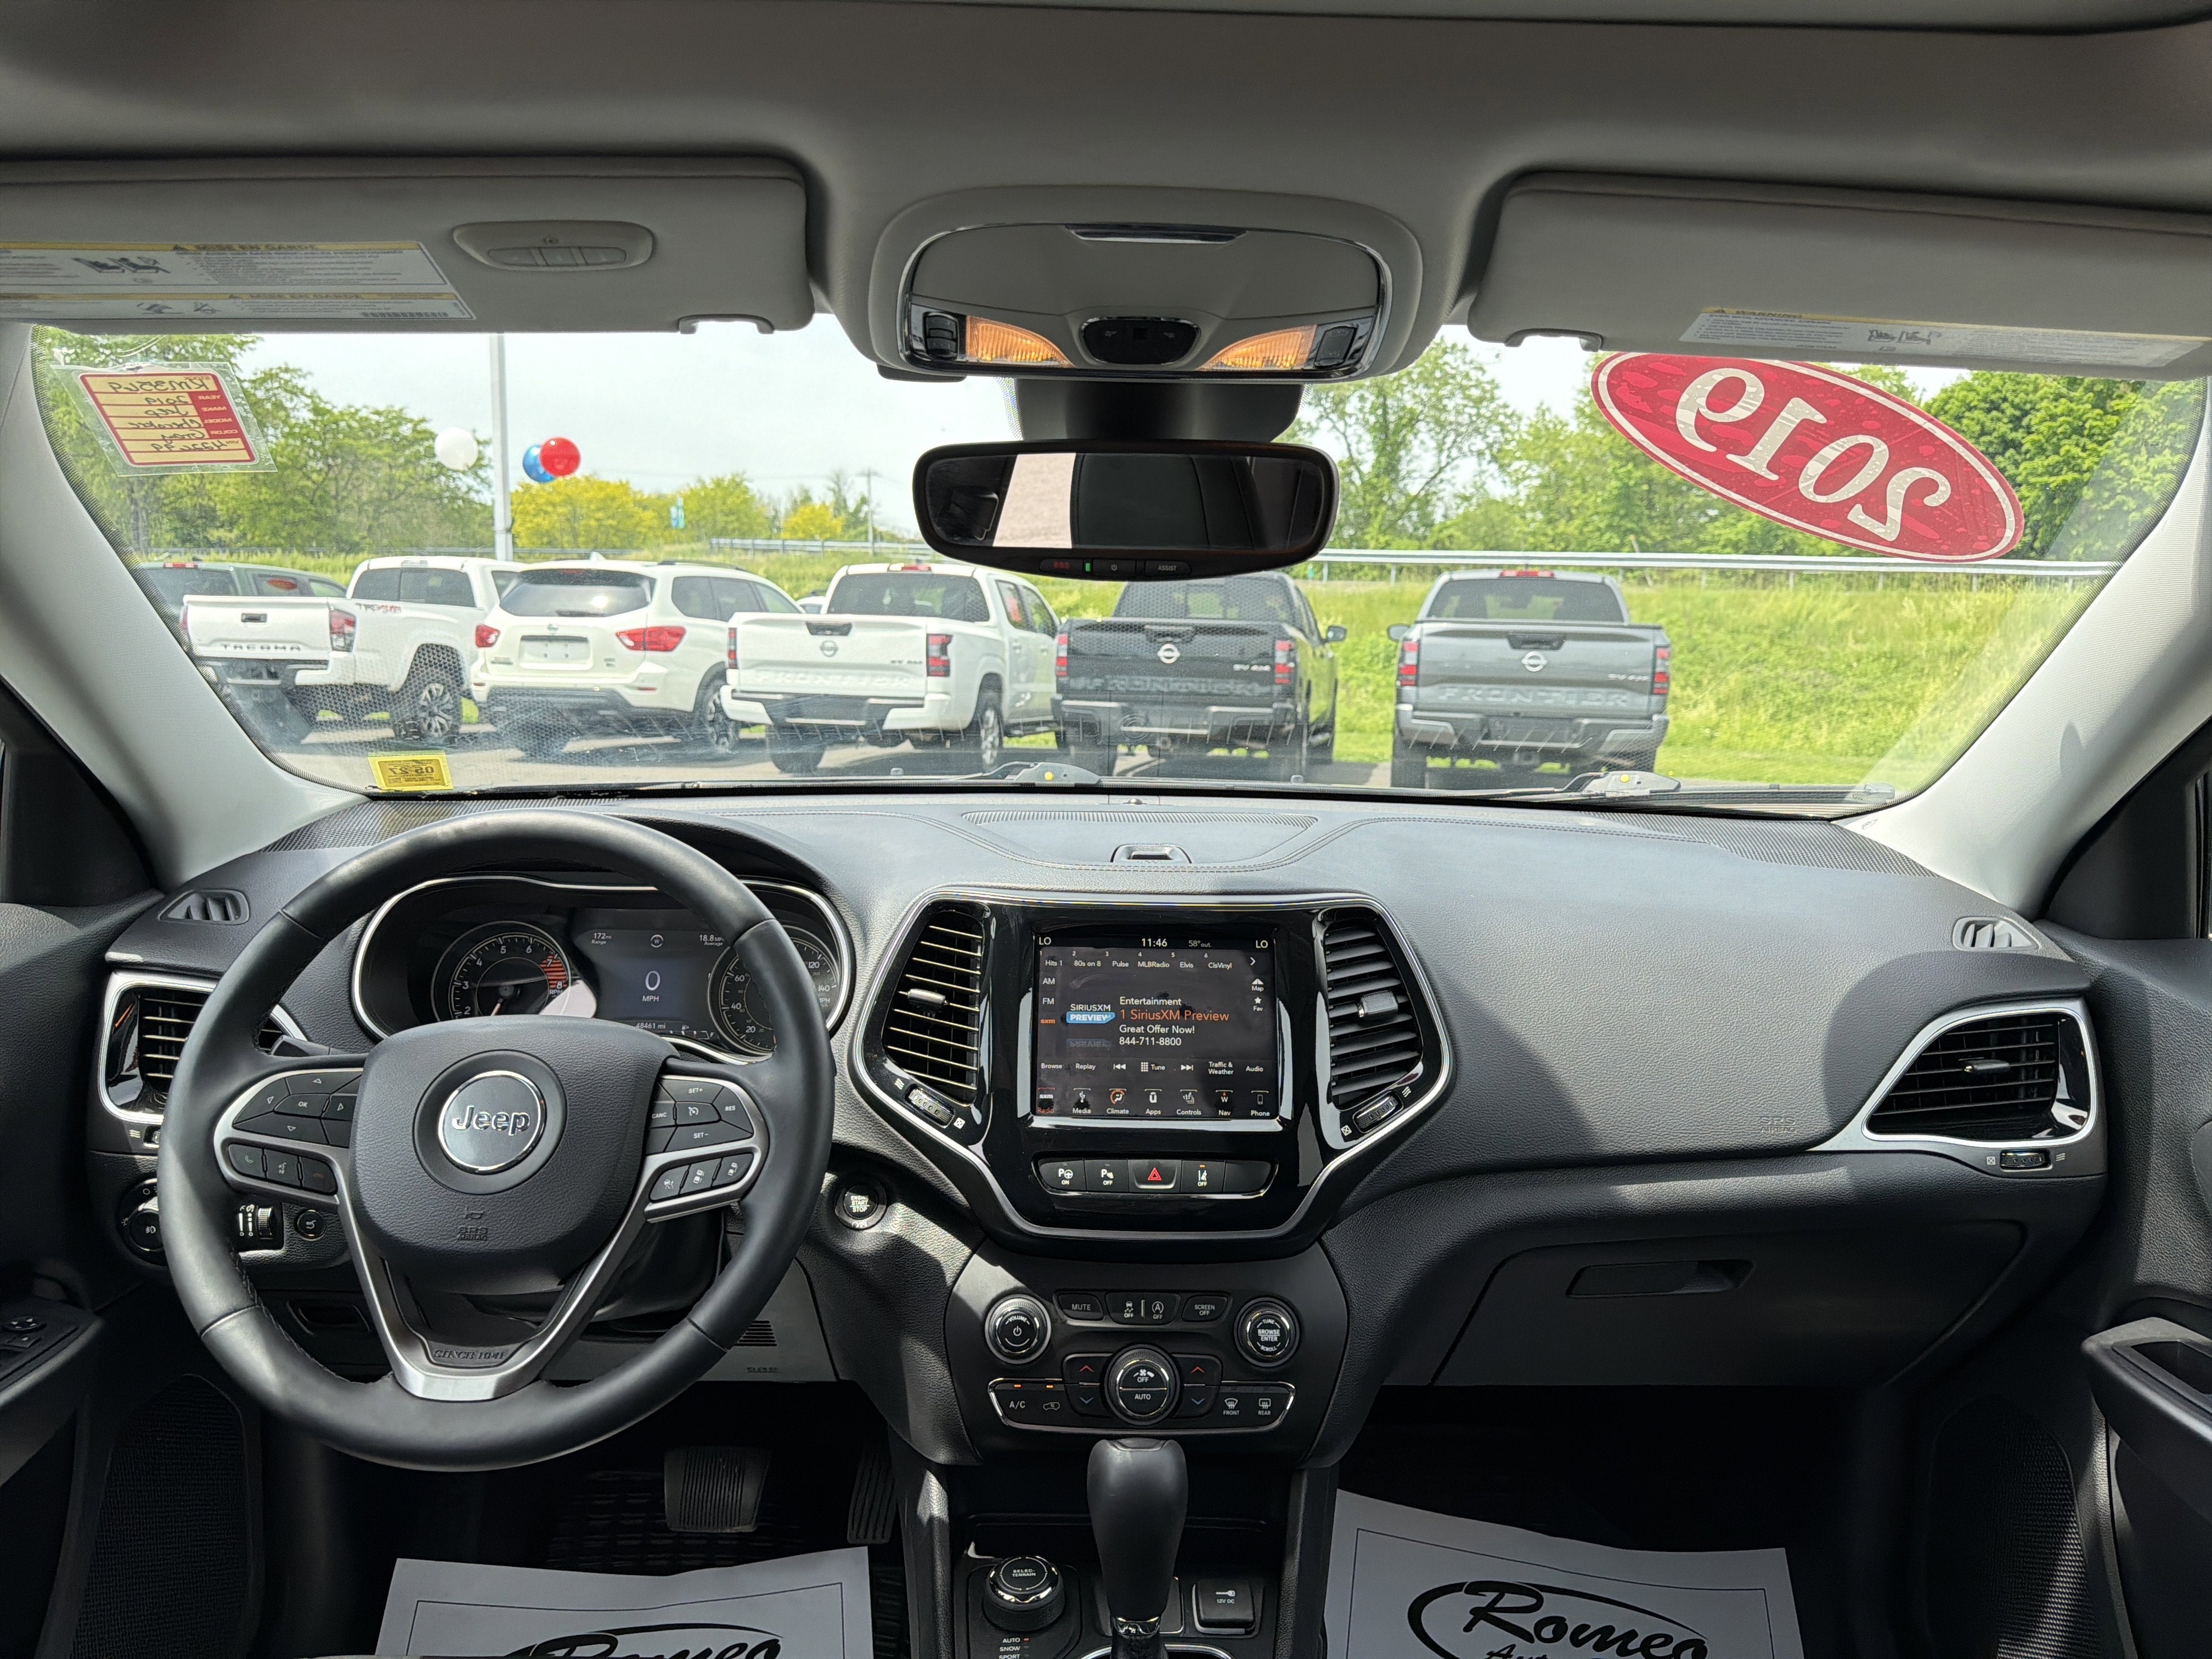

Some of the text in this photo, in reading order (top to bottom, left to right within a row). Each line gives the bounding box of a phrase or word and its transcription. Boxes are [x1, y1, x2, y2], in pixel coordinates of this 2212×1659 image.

[1437, 687, 1629, 708] FRONTIER
[1039, 936, 1052, 945] LO
[1141, 938, 1168, 947] 11:46
[1255, 940, 1268, 949] LO
[500, 946, 506, 954] 5
[526, 945, 532, 953] 6
[546, 959, 553, 967] 7
[556, 980, 563, 989] 8
[645, 970, 661, 991] 0
[462, 981, 470, 990] 3
[1119, 996, 1182, 1006] Entertainment
[464, 1006, 471, 1015] 2
[1120, 1009, 1229, 1022] 1 SiriusXM Preview
[1119, 1024, 1195, 1034] Great Offer Now!
[1119, 1036, 1182, 1046] 844-711-8800
[452, 1104, 531, 1136] Jeep
[1760, 1116, 1796, 1125] SRS
[1071, 1303, 1091, 1311] MUTE
[1009, 1400, 1026, 1409] A/C
[1463, 1581, 1708, 1659] Romeo
